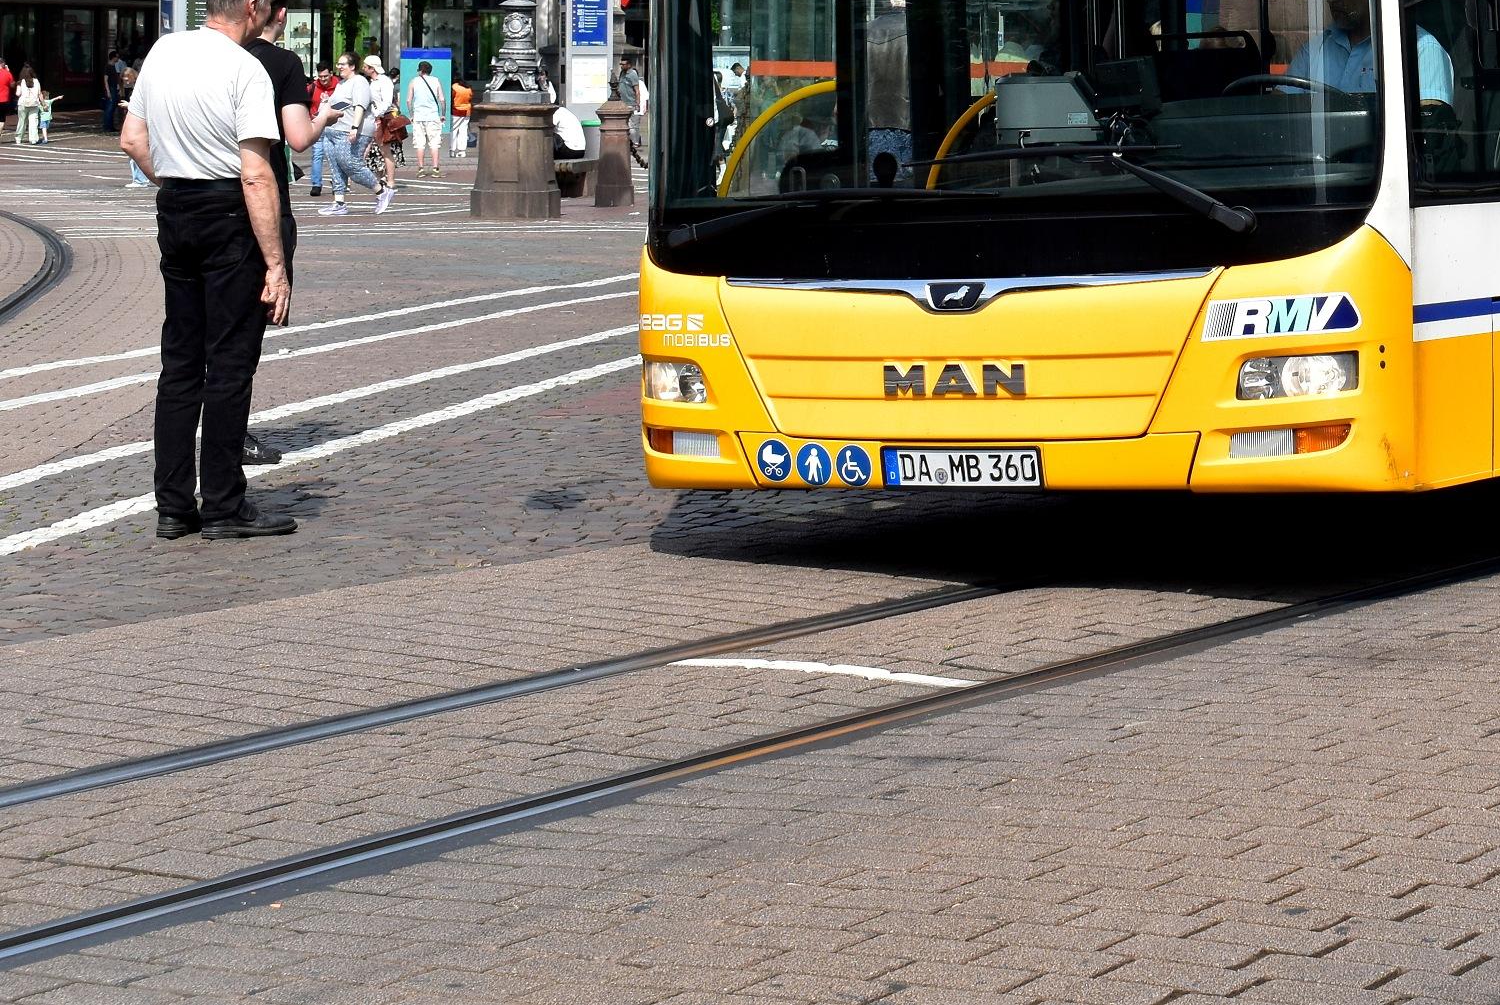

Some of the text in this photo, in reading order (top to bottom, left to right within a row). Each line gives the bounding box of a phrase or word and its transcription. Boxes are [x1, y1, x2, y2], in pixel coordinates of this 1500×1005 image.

[1231, 294, 1345, 336] RMV
[883, 363, 1027, 397] MAN
[900, 453, 932, 482] DA
[949, 453, 982, 482] MB
[987, 453, 1037, 482] 360
